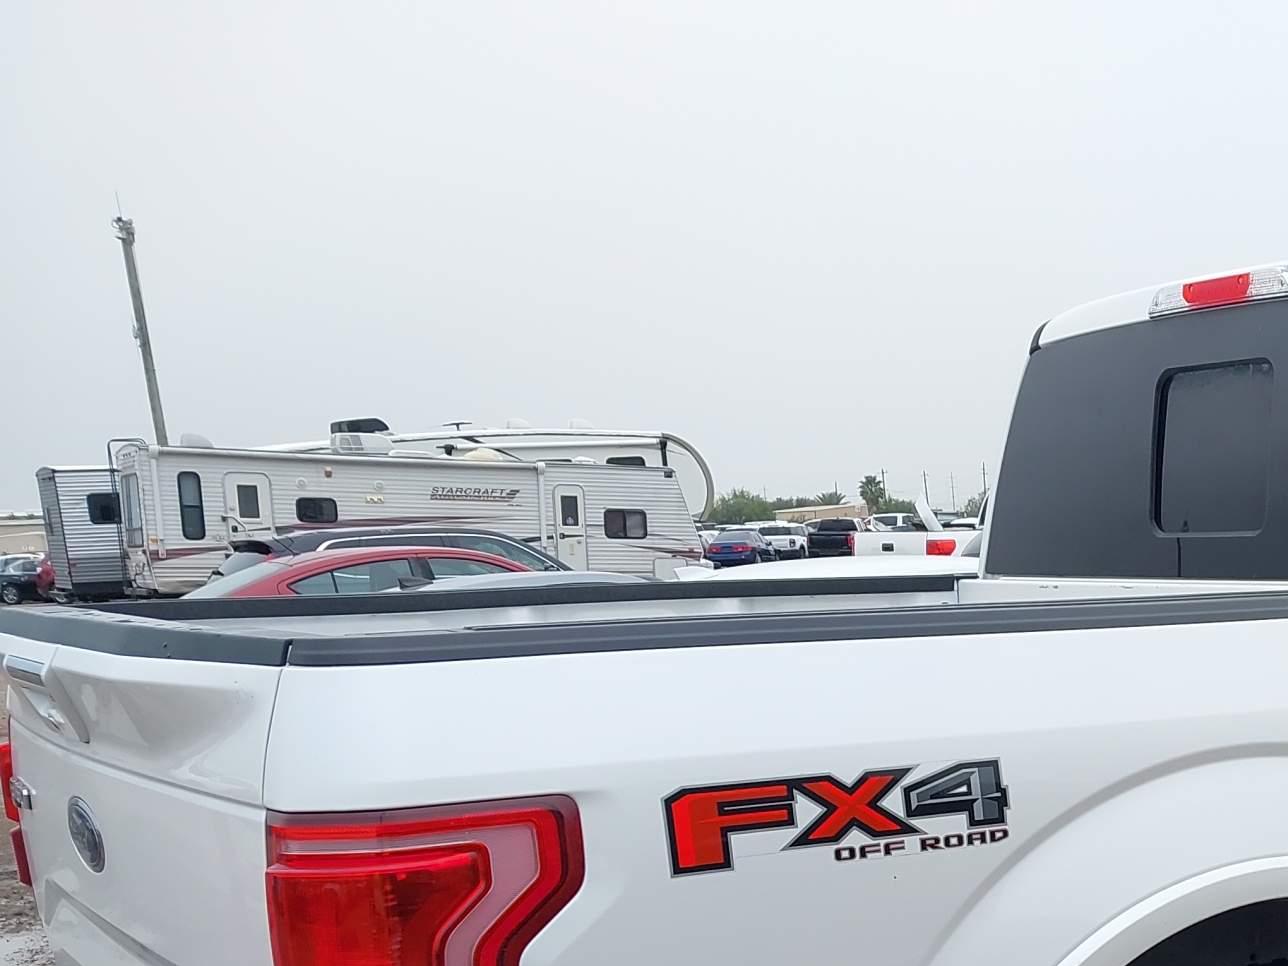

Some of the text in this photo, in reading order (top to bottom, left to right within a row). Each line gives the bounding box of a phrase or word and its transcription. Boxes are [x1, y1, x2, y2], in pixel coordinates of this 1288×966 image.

[431, 486, 506, 496] STARCRAFT
[661, 756, 1010, 878] FX4
[834, 828, 1010, 862] OFF ROAD
